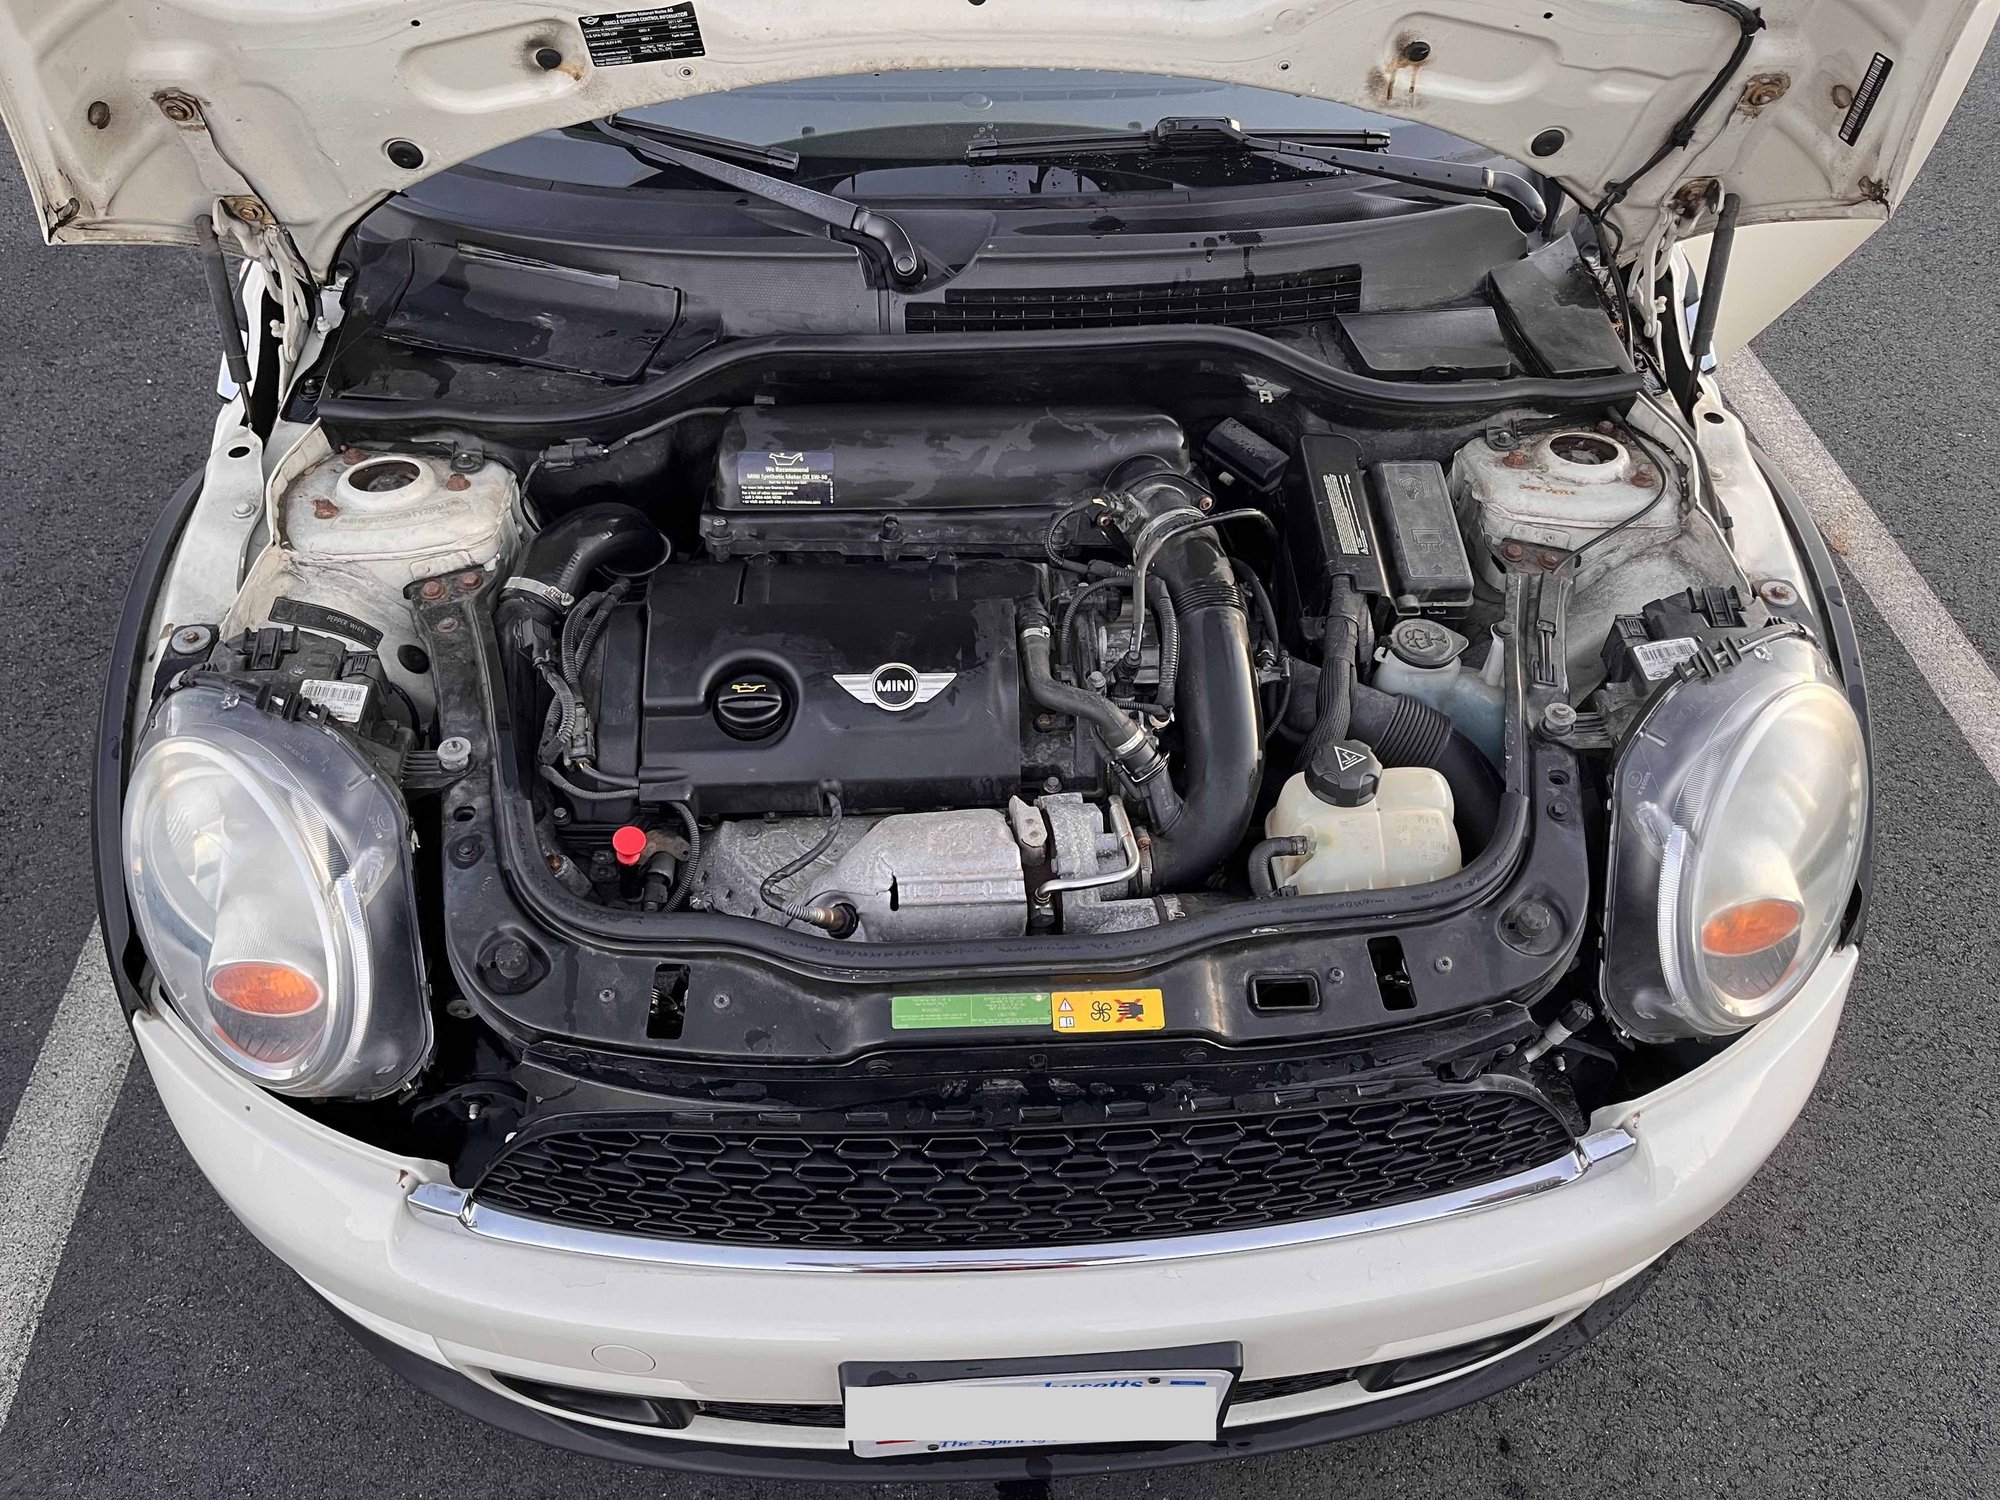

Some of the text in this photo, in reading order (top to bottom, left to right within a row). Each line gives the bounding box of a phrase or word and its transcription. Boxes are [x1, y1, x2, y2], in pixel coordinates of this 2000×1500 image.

[326, 614, 367, 635] PEPPER WHITE
[876, 680, 914, 692] MINI
